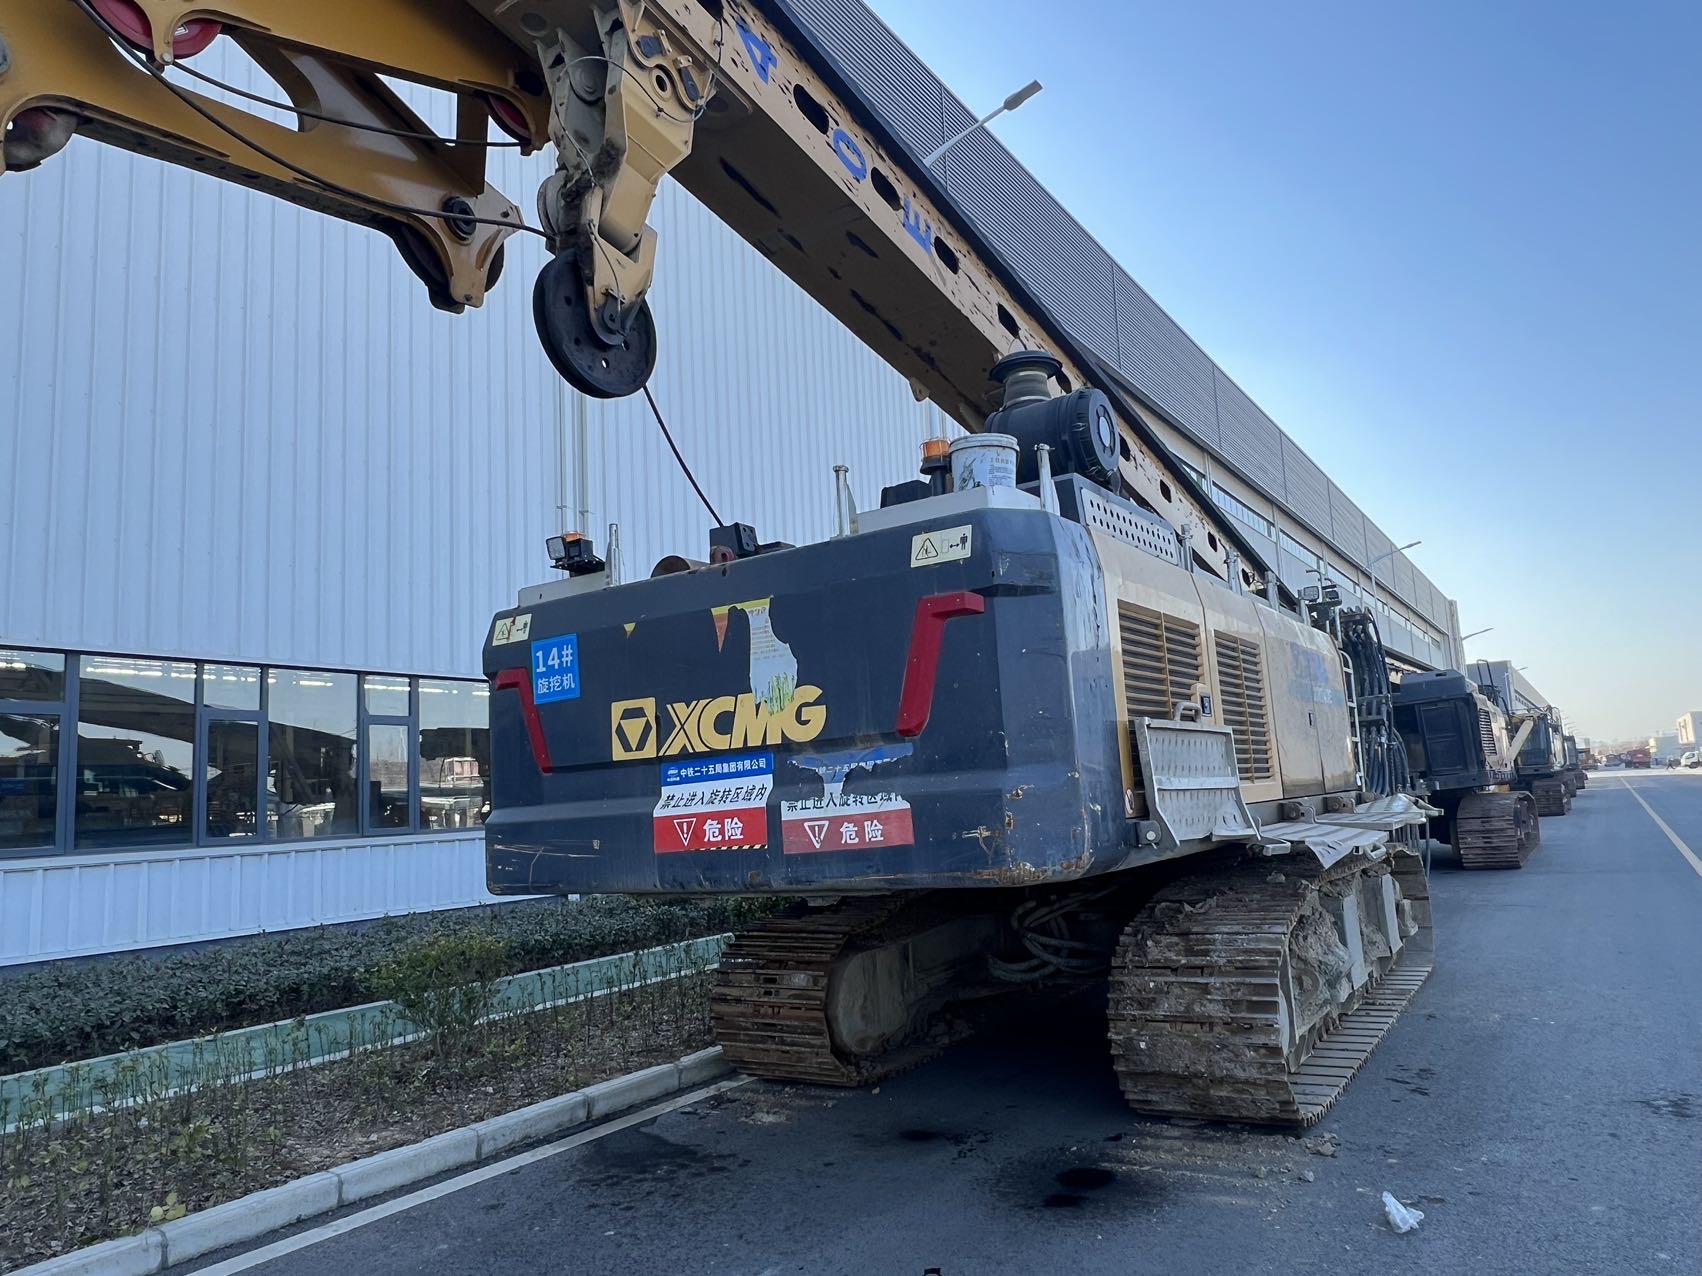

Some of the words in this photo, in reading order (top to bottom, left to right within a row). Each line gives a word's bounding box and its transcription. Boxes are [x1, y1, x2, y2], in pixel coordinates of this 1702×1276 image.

[535, 644, 573, 673] 14#
[537, 673, 576, 694] 旋挖机
[658, 685, 827, 757] XCMG
[680, 757, 767, 778] 中铁二十五局集团有限公司
[659, 783, 768, 810] 禁止进入旋转区域内
[703, 816, 744, 843] 危险
[839, 819, 885, 845] 危险
